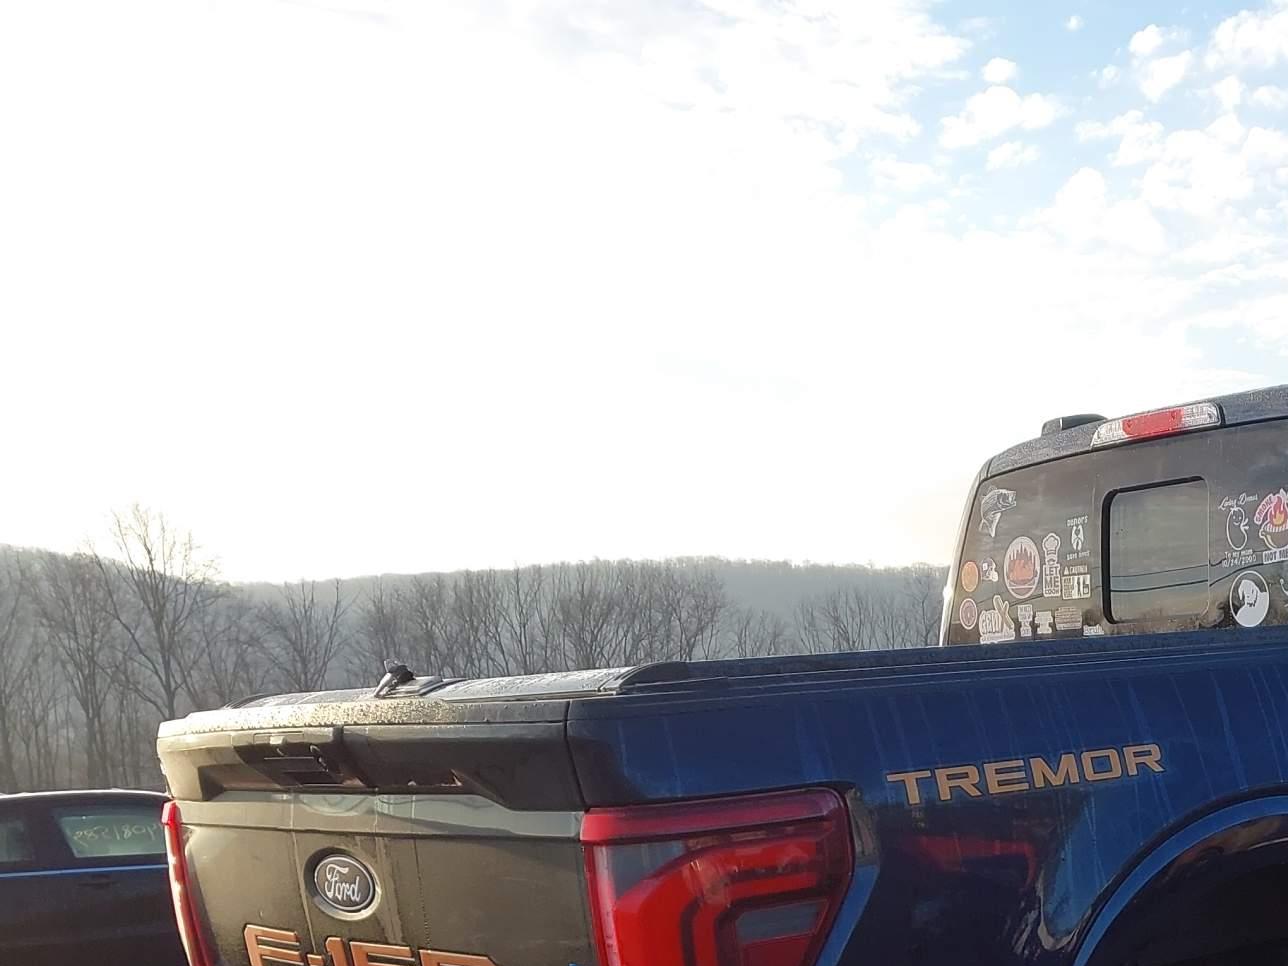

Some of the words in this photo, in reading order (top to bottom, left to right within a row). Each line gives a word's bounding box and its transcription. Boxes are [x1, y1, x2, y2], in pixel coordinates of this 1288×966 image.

[1044, 566, 1059, 576] LET
[1044, 576, 1059, 589] ME
[886, 742, 1165, 805] TREMOR
